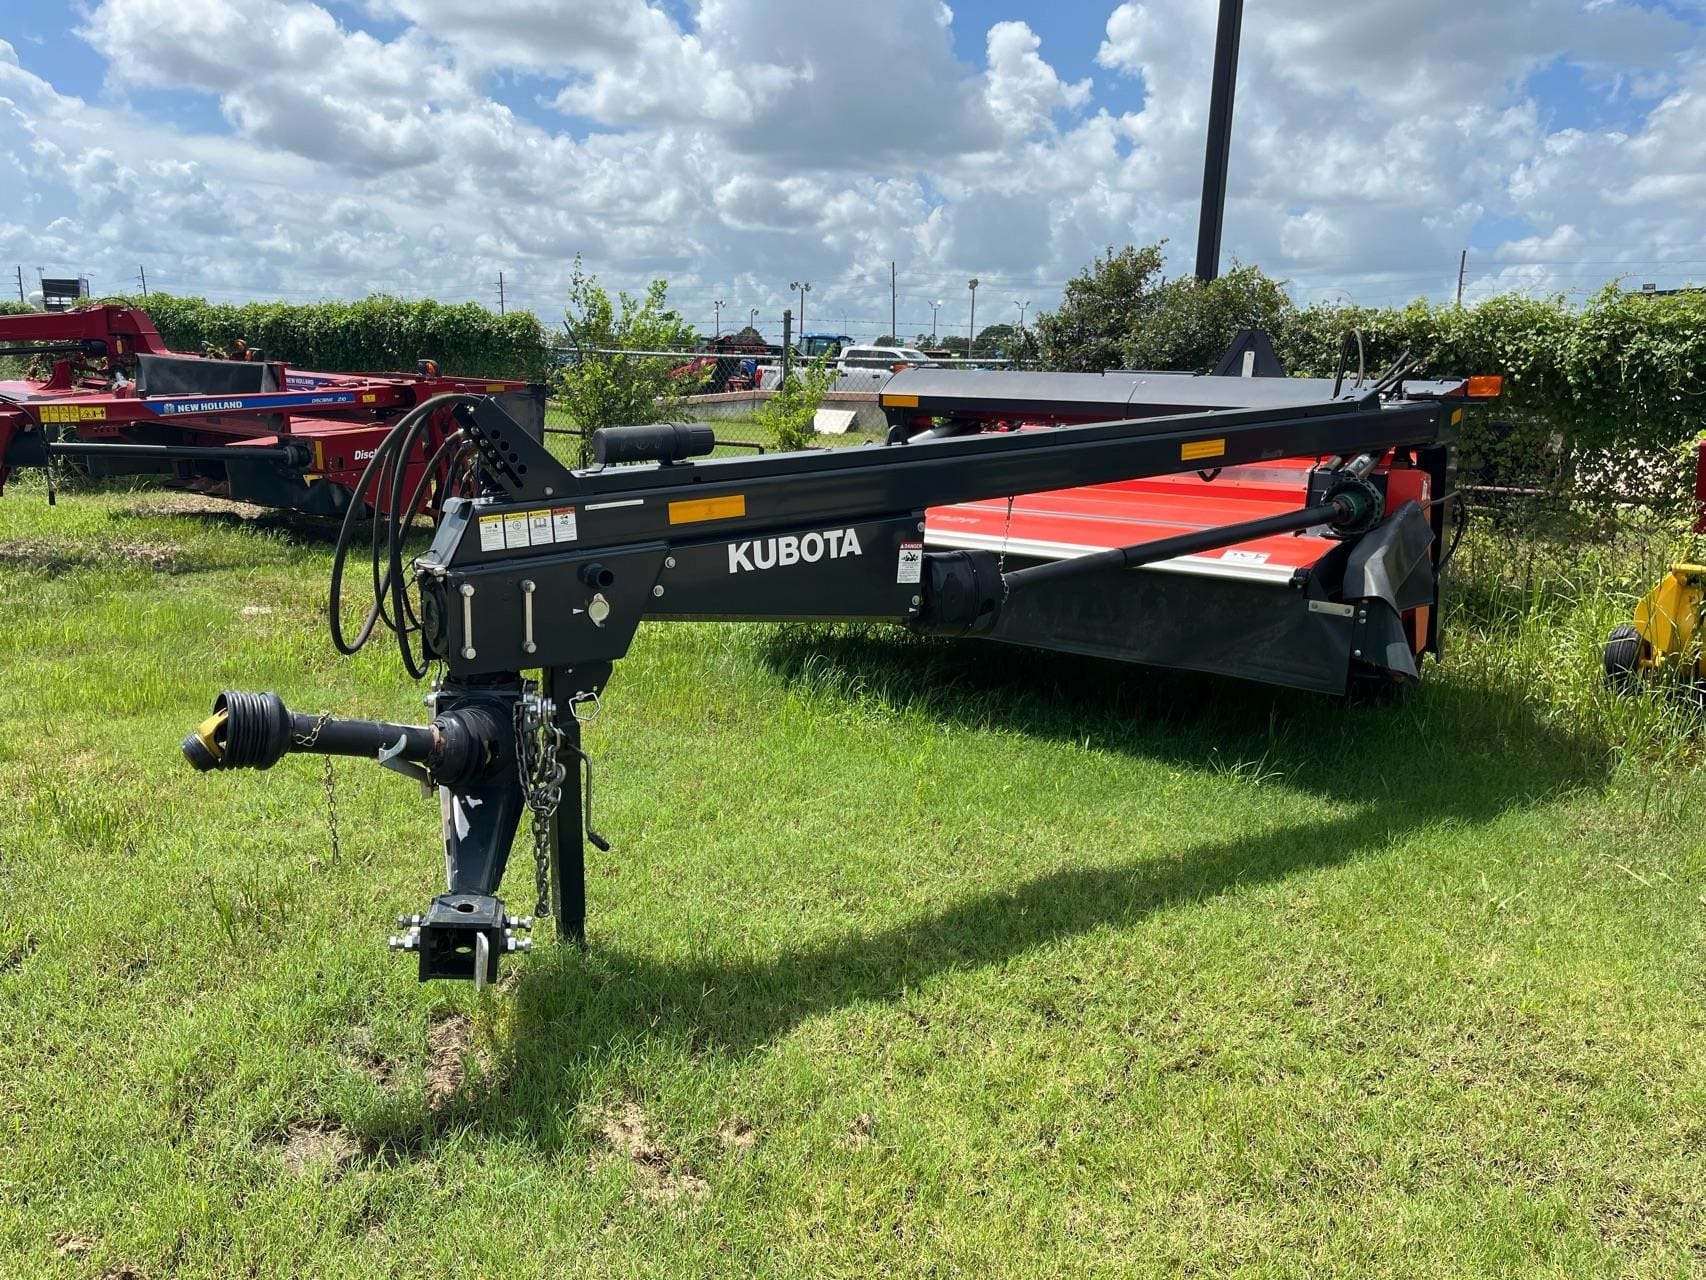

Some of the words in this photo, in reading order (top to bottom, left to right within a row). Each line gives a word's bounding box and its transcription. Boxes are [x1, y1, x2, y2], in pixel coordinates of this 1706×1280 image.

[177, 404, 199, 413] NEW
[201, 401, 243, 411] HOLLAND
[727, 528, 863, 574] KUBOTA
